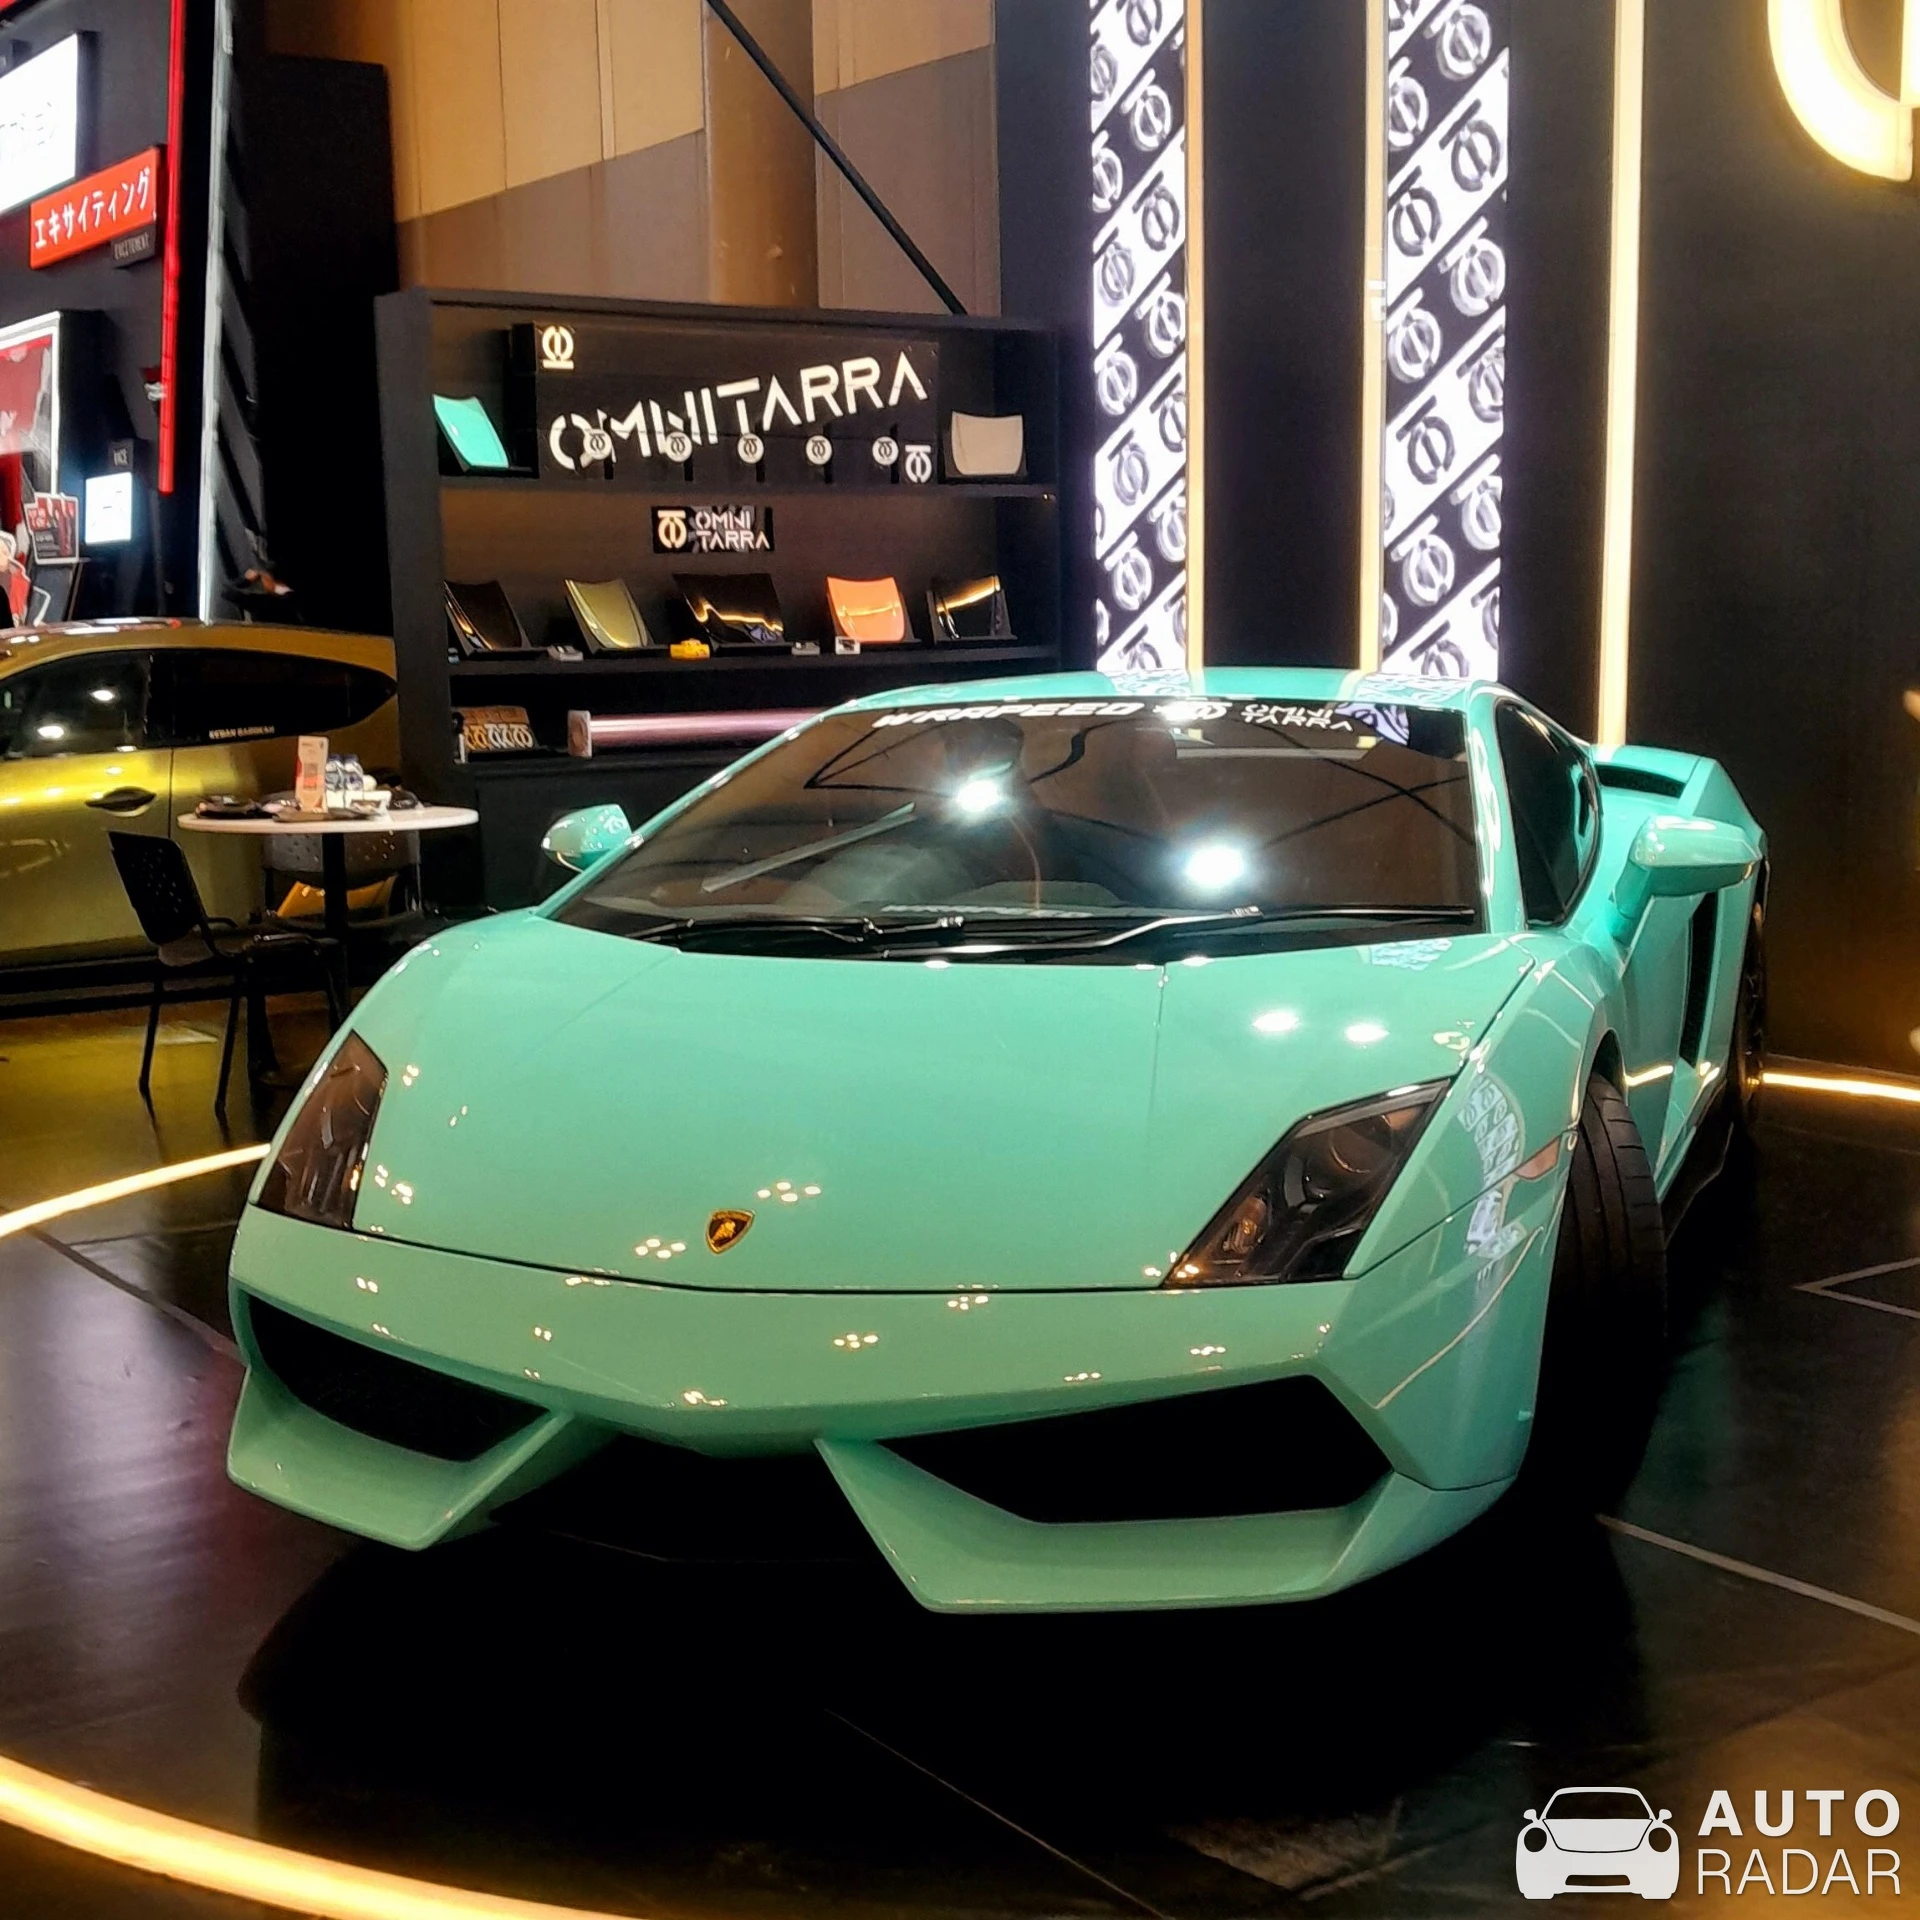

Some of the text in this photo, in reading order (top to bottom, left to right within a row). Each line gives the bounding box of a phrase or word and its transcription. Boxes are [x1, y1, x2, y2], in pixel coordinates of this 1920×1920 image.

[34, 166, 151, 249] エキサイティング
[549, 351, 928, 471] OMNITARRA
[695, 510, 751, 530] OMNI
[695, 530, 771, 552] TARRA
